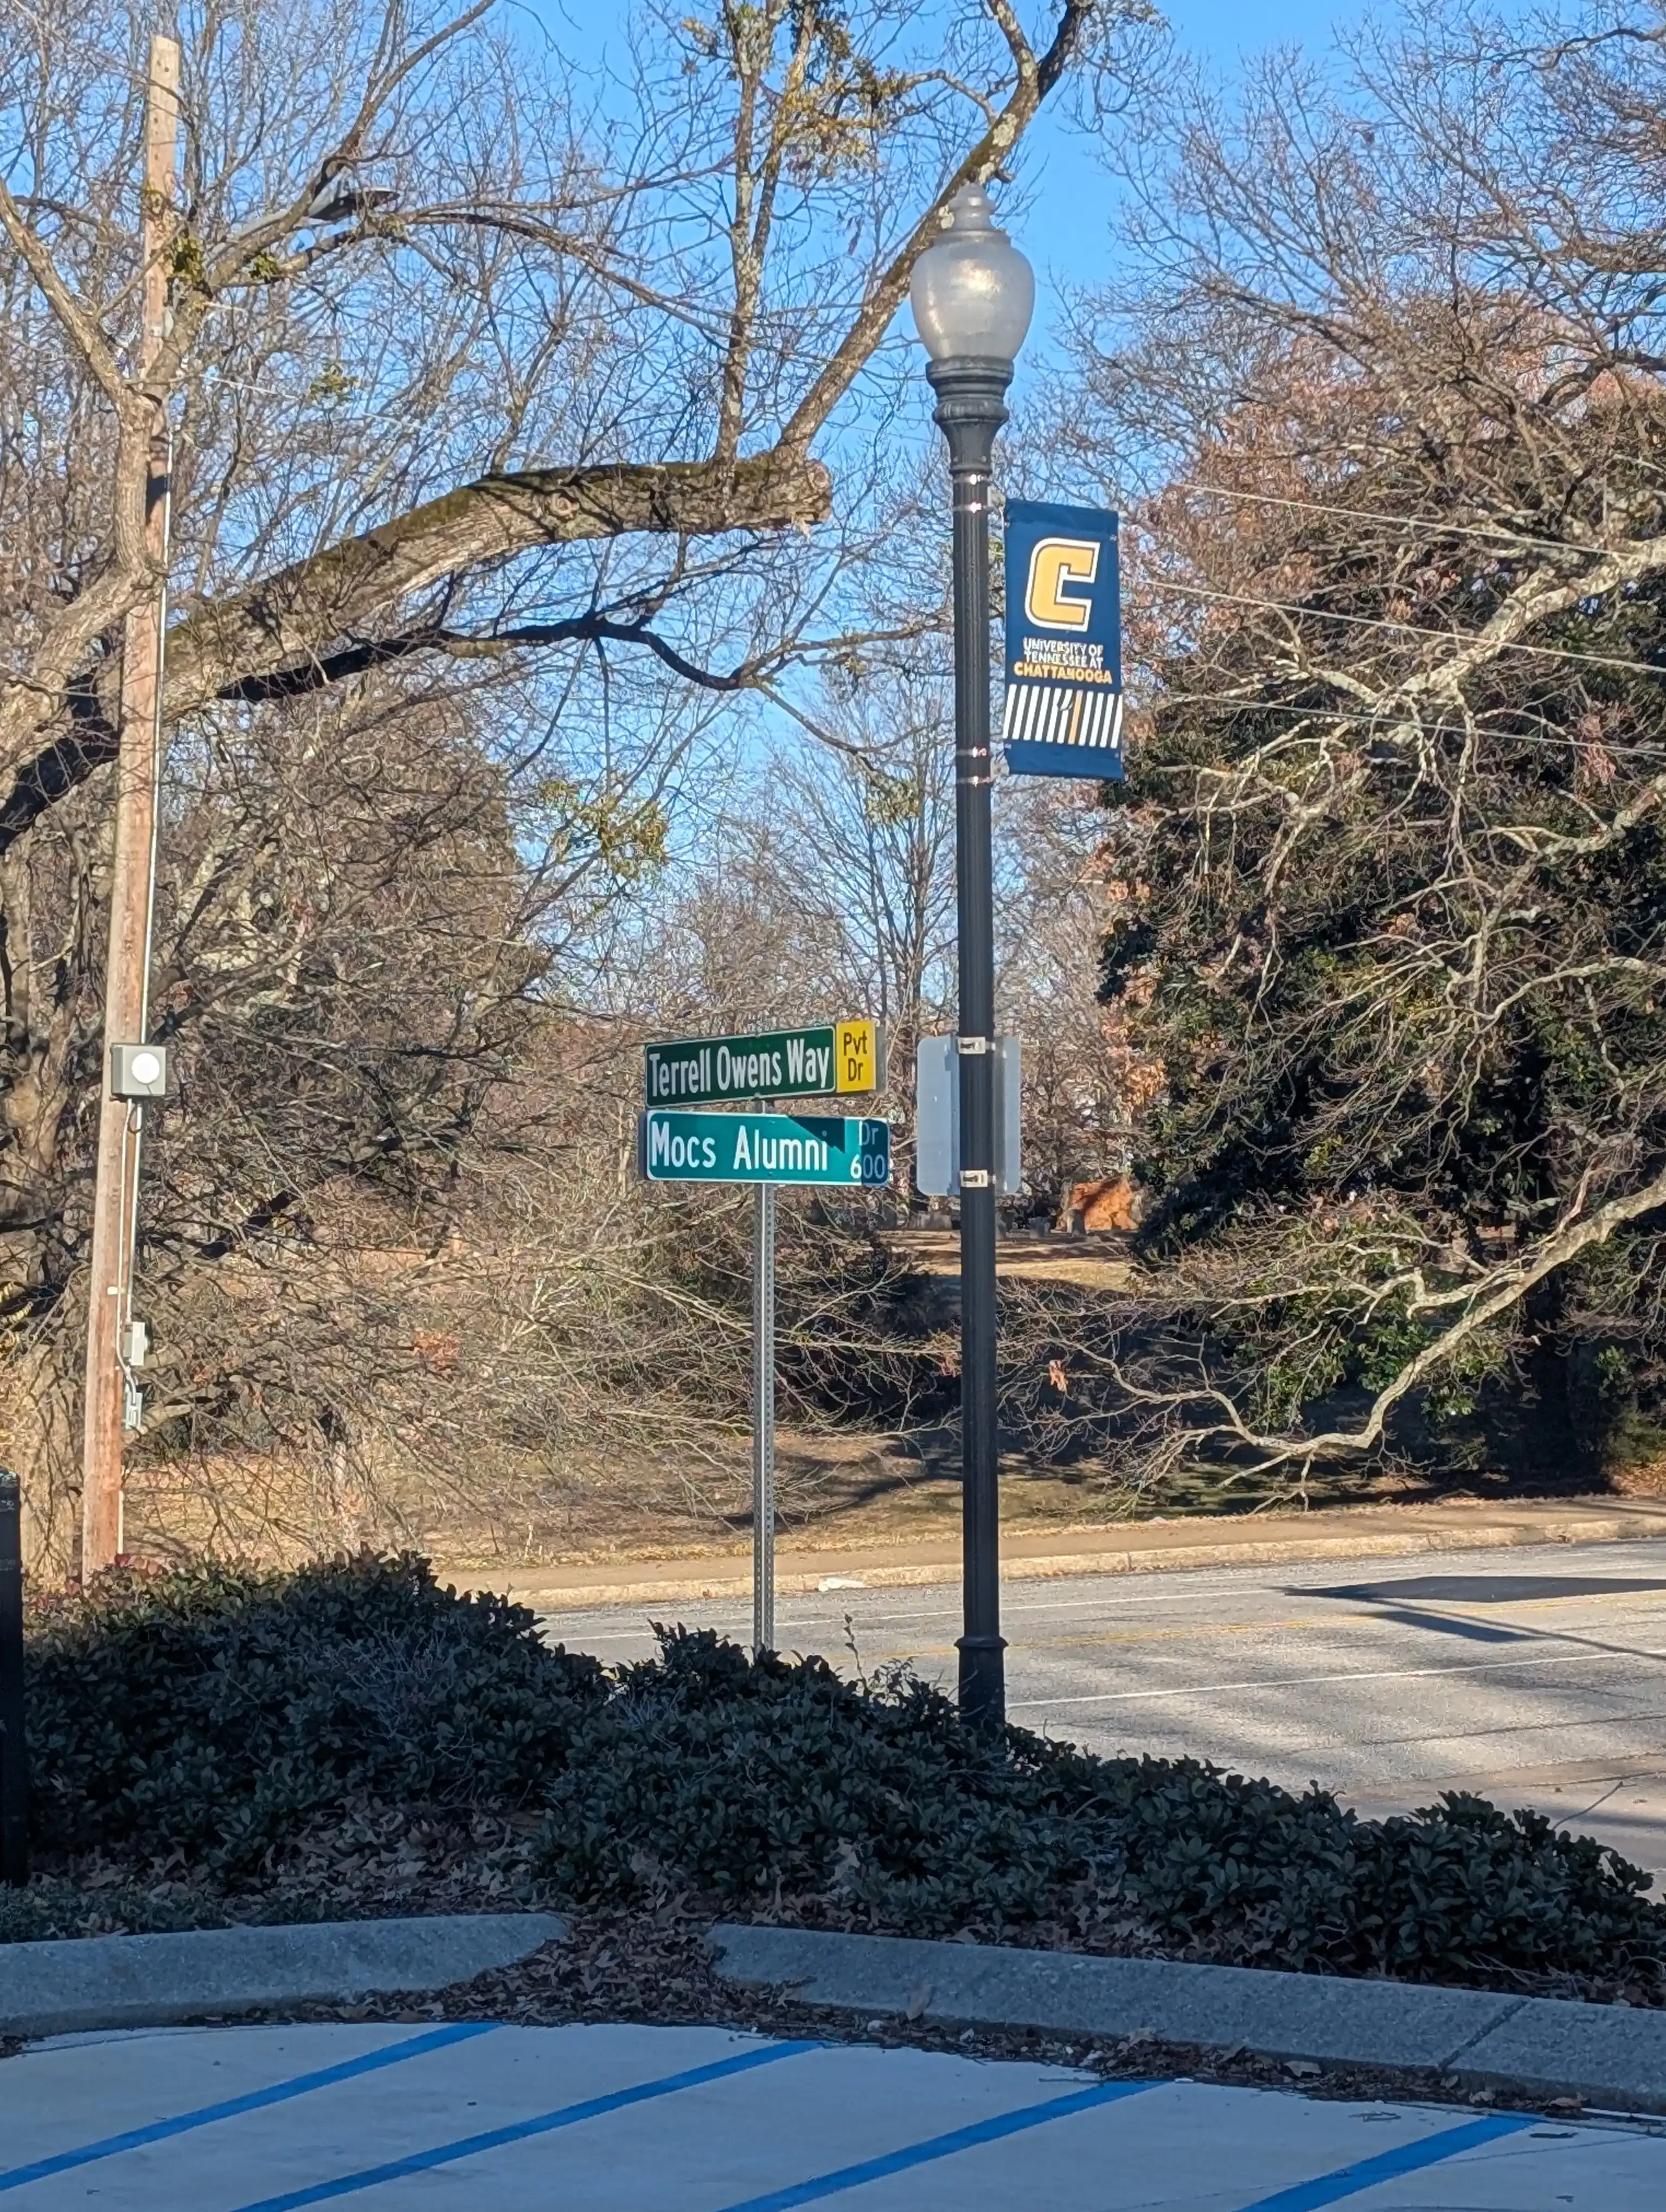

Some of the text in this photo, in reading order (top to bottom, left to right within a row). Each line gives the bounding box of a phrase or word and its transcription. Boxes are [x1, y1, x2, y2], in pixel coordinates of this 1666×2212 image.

[1024, 537, 1100, 632] C
[1023, 636, 1104, 657] UNIVERSITY OF
[1014, 661, 1112, 684] CHATTANOOGA
[1024, 651, 1104, 670] TENNESSEE AT
[843, 1031, 868, 1057] Pvt
[649, 1038, 830, 1097] Terrell Owens Way
[848, 1058, 864, 1082] Dr
[651, 1121, 828, 1171] Mocs Alumni
[860, 1121, 879, 1146] Dr
[850, 1154, 886, 1179] 600
